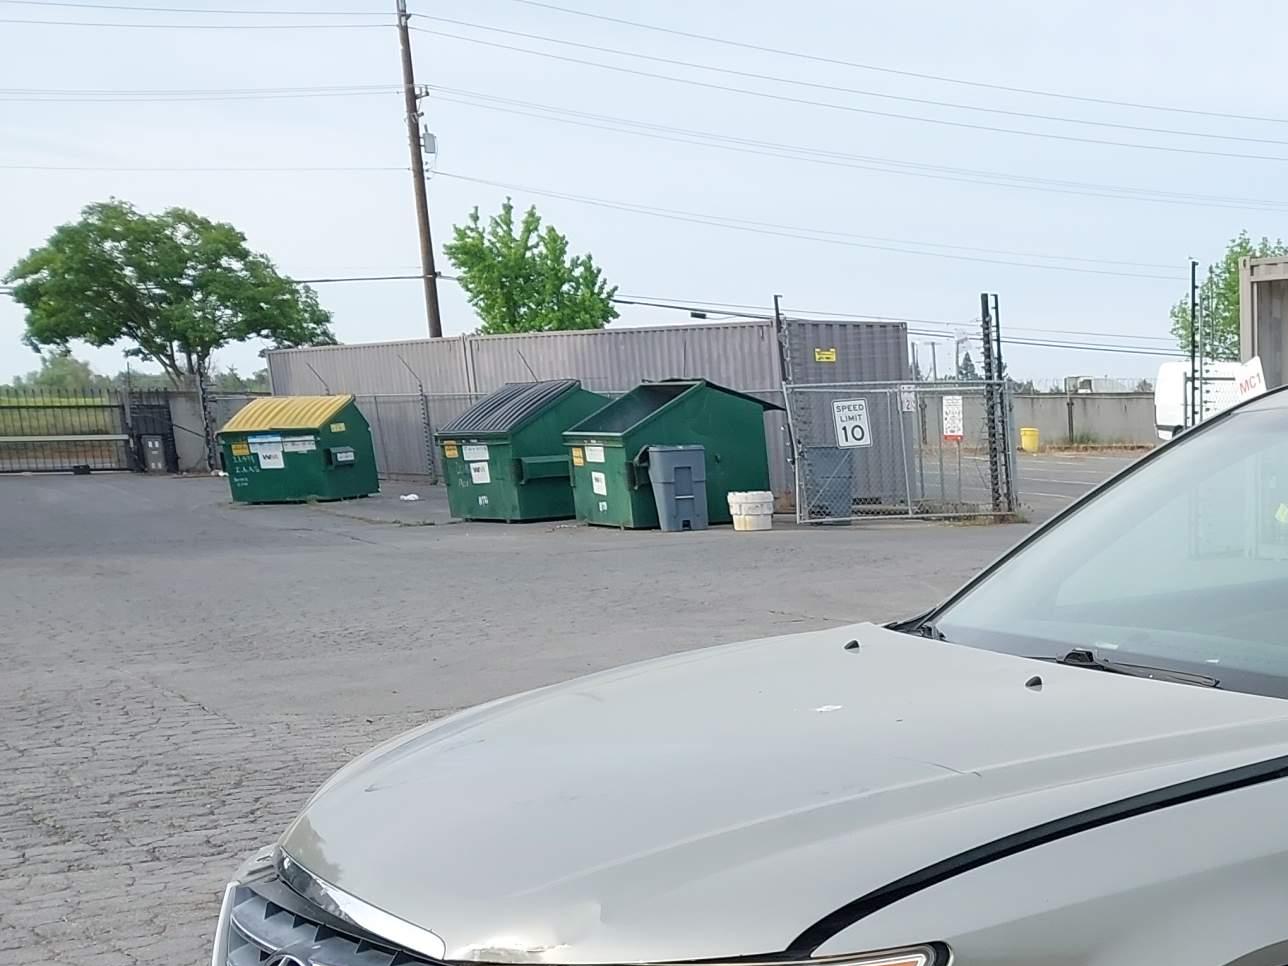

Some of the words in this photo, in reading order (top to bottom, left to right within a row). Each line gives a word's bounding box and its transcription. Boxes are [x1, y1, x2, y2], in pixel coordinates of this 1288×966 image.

[836, 405, 864, 413] SPEED
[840, 414, 862, 422] LIMIT
[842, 424, 864, 442] 10
